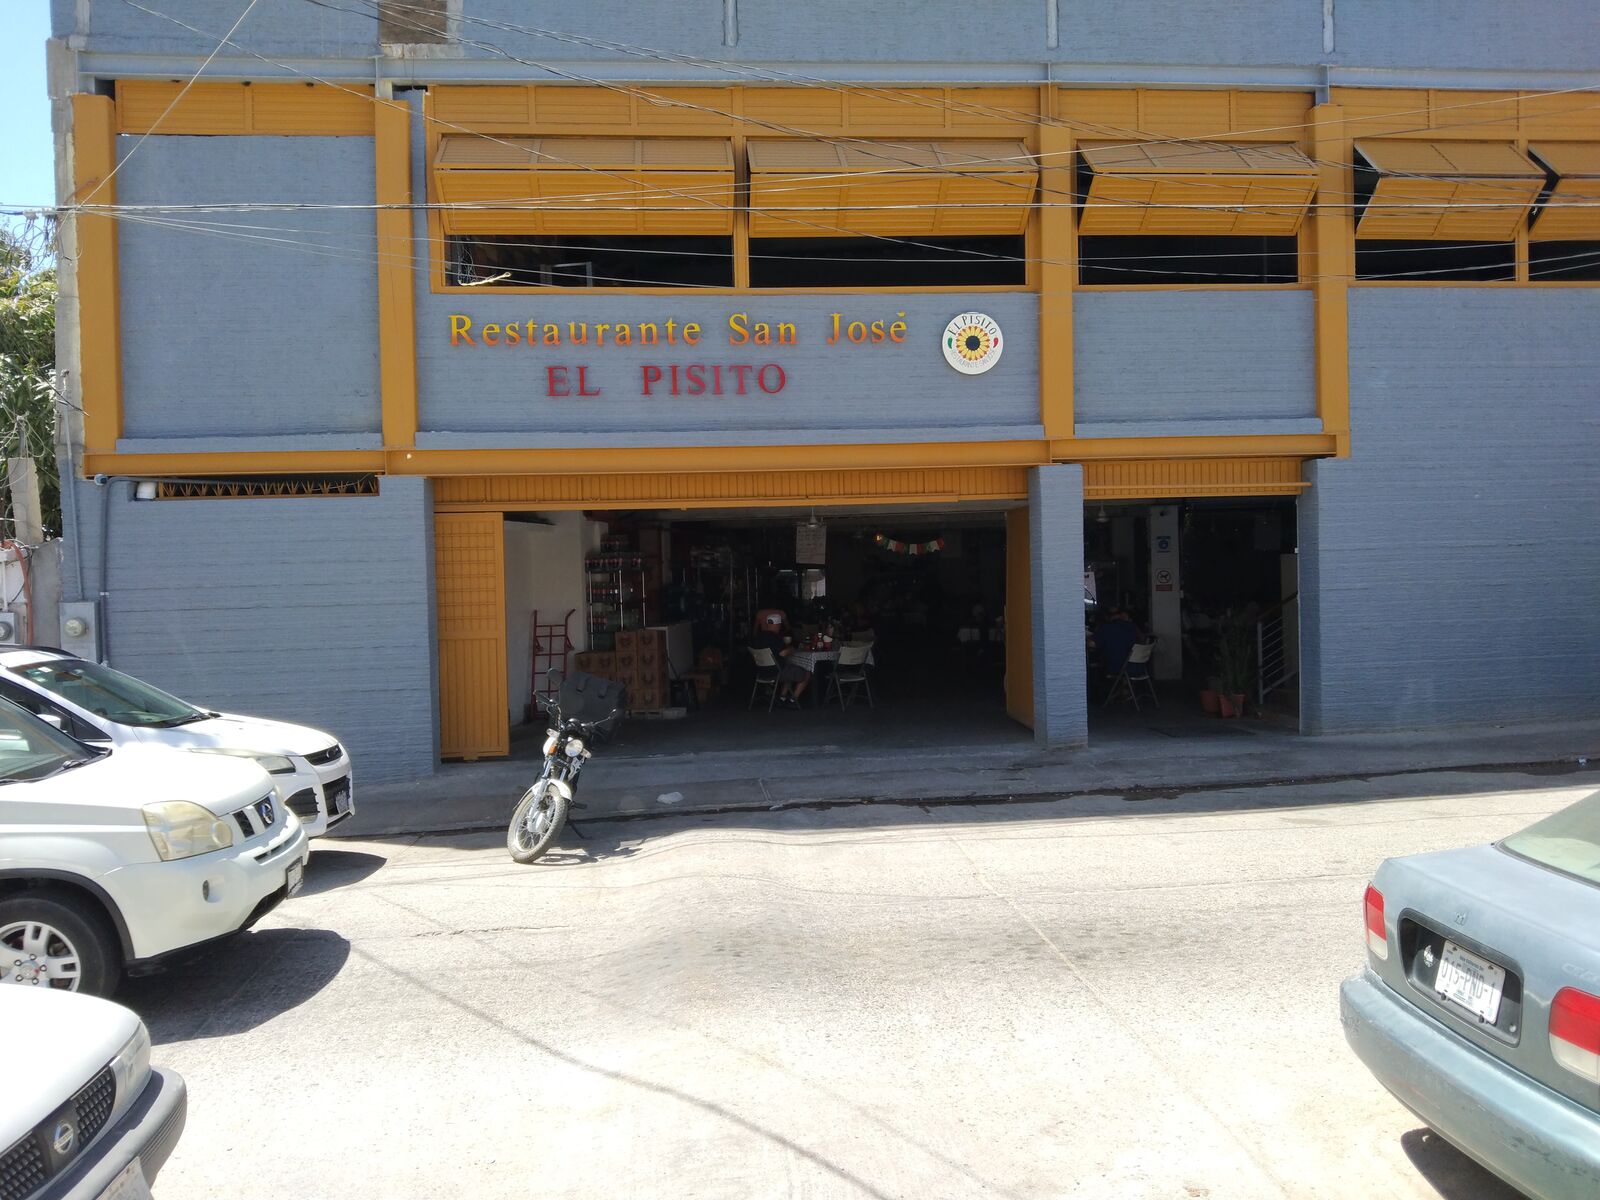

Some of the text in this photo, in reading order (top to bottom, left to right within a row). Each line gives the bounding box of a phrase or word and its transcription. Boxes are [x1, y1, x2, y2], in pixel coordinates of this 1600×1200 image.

[448, 311, 907, 347] Restaurante San José
[961, 315, 997, 334] PISITO
[545, 363, 786, 397] EL PISITO
